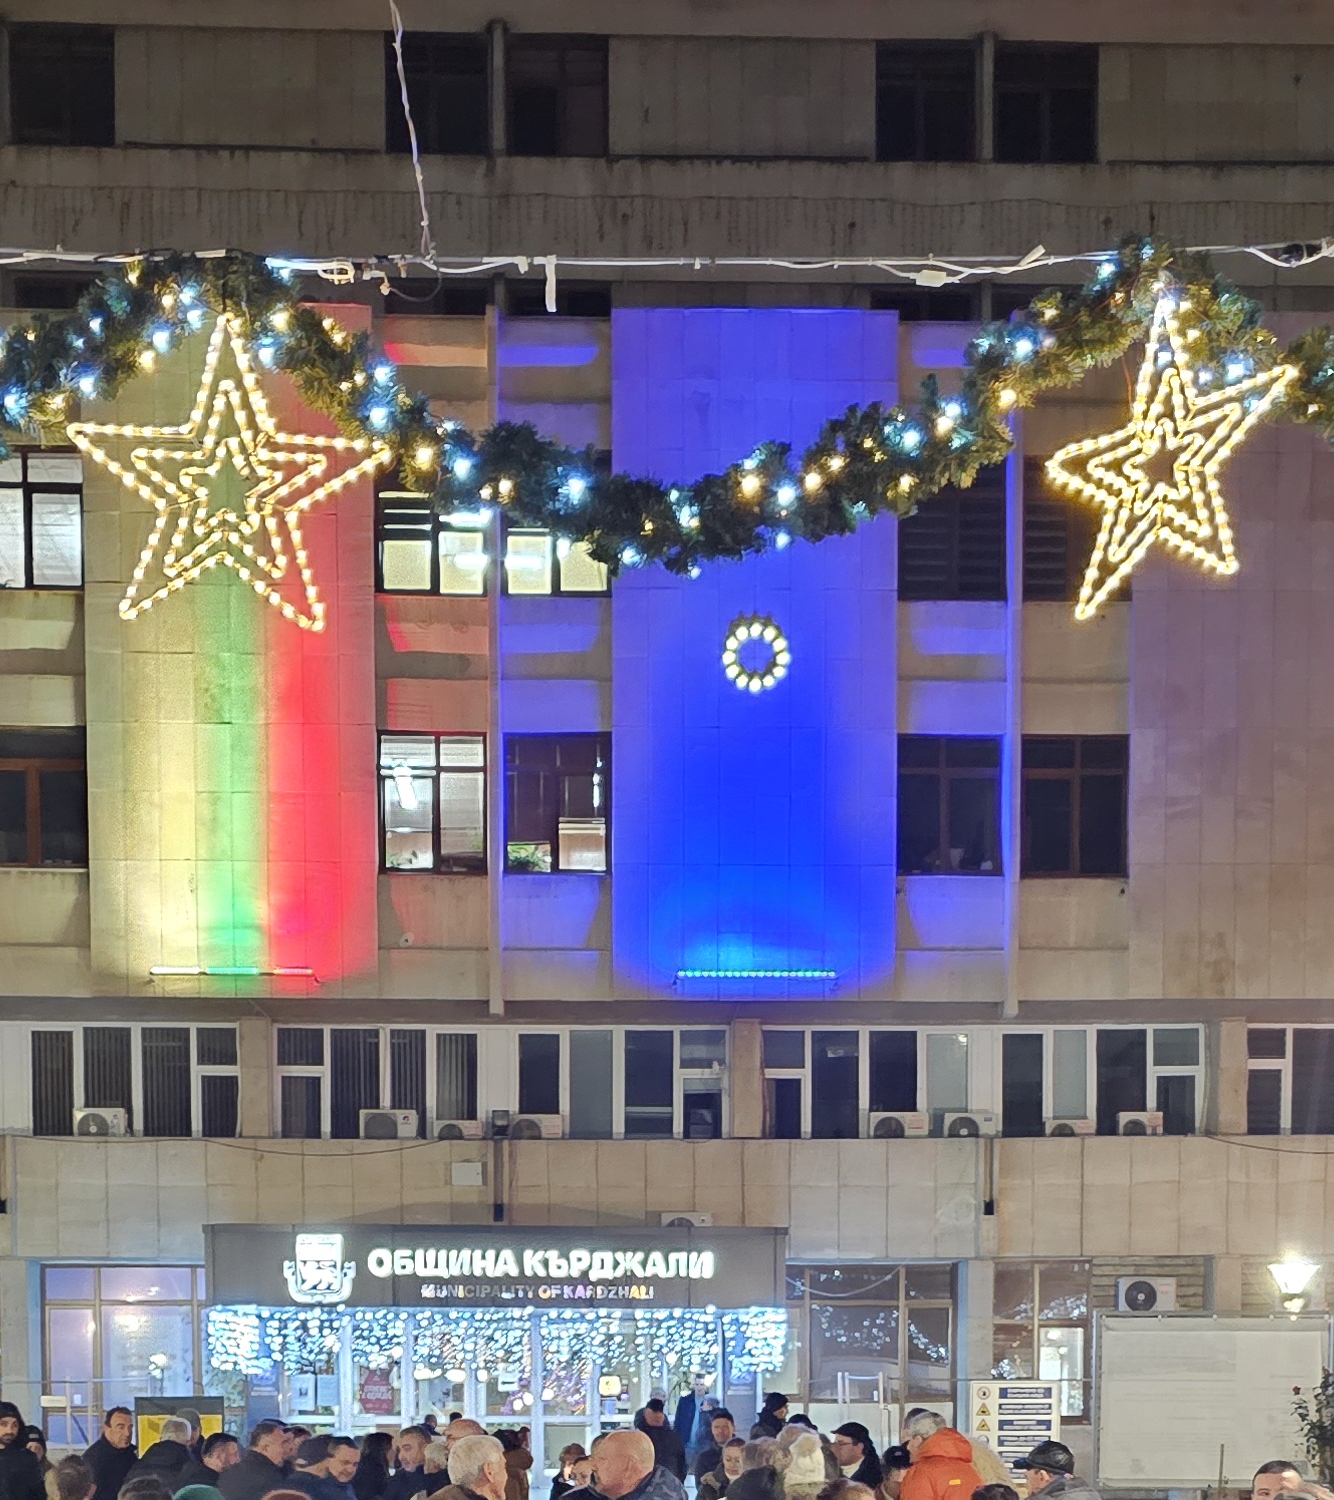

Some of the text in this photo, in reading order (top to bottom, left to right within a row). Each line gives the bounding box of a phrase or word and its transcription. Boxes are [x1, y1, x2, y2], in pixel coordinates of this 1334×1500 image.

[368, 1248, 714, 1281] ОБЩИНА КЪРДЖАЛИ
[420, 1284, 655, 1299] MUNICIPALITY OF KARDZHALI
